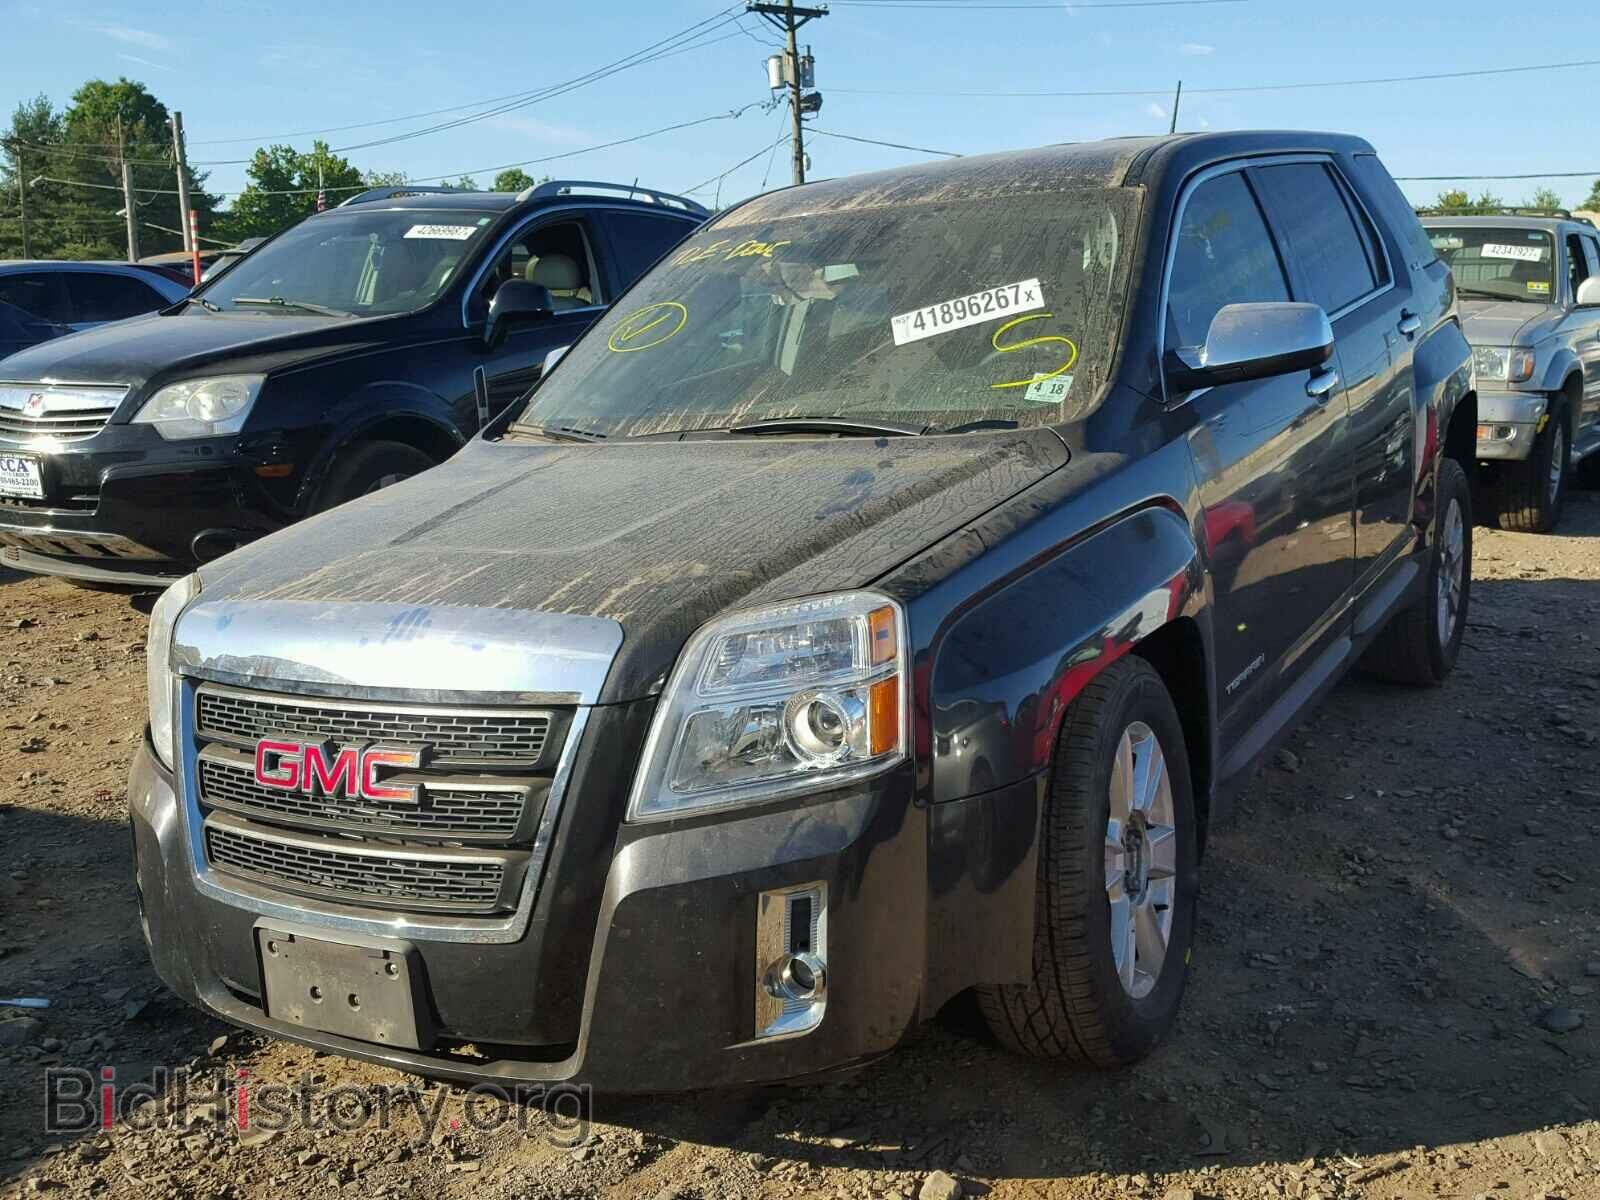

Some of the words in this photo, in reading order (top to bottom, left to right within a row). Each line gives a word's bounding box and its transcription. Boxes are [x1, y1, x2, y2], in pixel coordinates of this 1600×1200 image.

[913, 284, 1020, 331] 41896267
[1049, 383, 1064, 394] 18
[255, 738, 425, 804] GMC
